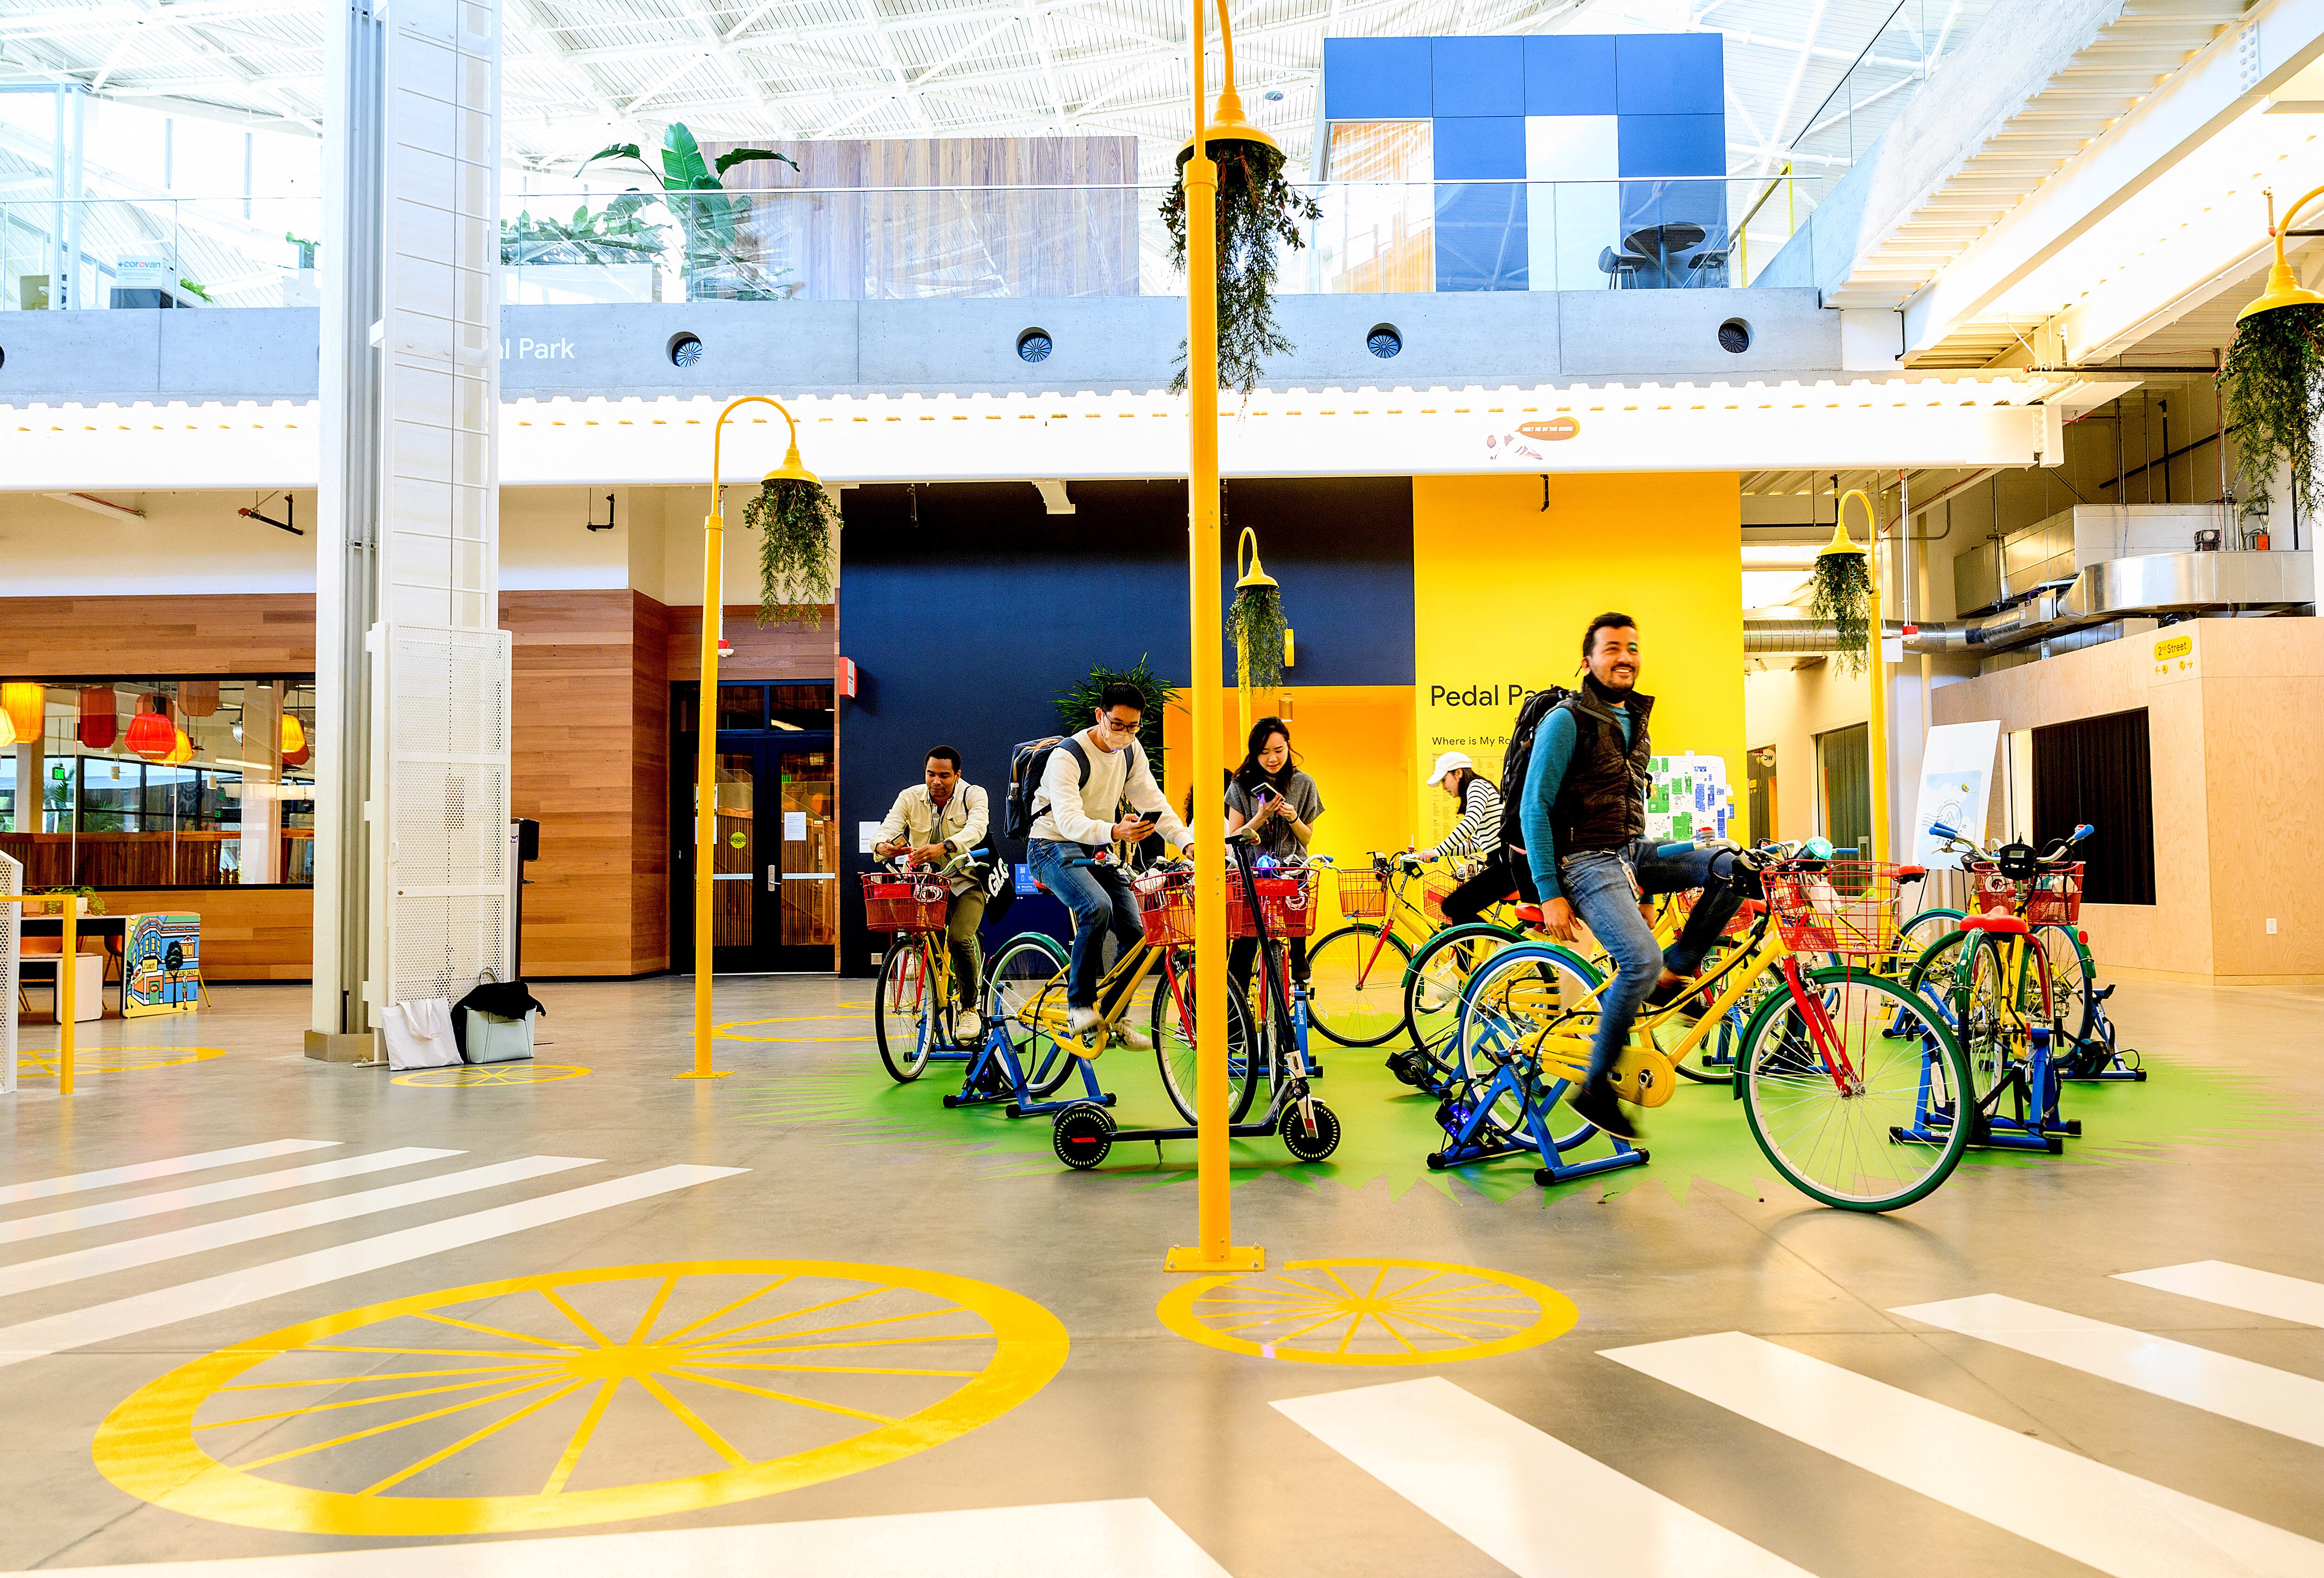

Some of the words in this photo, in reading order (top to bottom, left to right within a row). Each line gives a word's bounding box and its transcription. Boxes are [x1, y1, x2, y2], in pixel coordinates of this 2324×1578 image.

[519, 337, 575, 359] Park
[2167, 641, 2186, 653] Street
[1431, 685, 1498, 706] Pedal
[1432, 737, 1465, 745] Where
[1469, 736, 1477, 745] is
[1480, 736, 1495, 747] My
[1499, 736, 1511, 745] Ro
